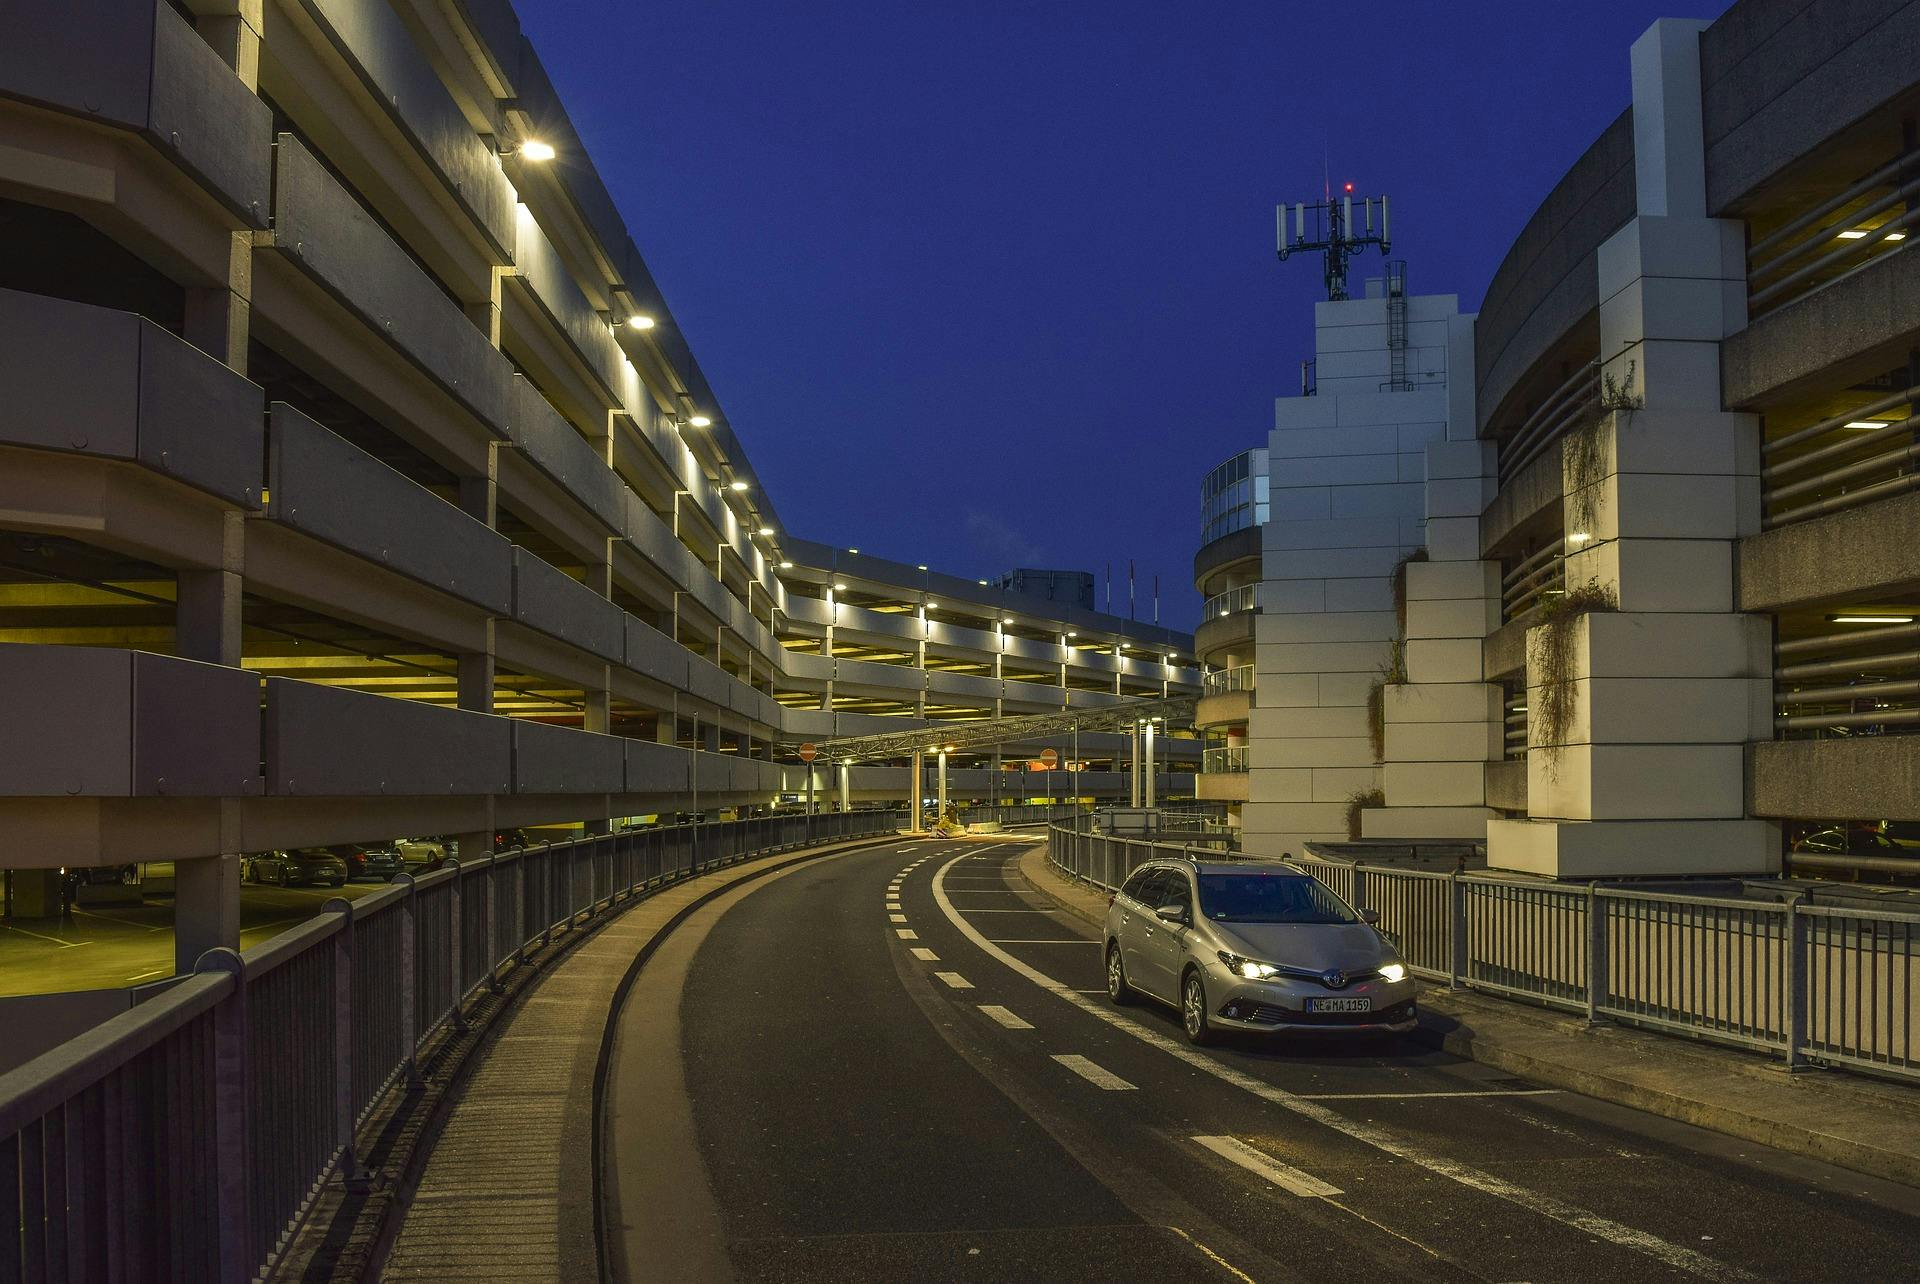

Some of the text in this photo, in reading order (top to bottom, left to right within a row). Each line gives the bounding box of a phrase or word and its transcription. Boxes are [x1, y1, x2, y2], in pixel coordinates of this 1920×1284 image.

[1313, 1000, 1369, 1011] NE MA 1159
